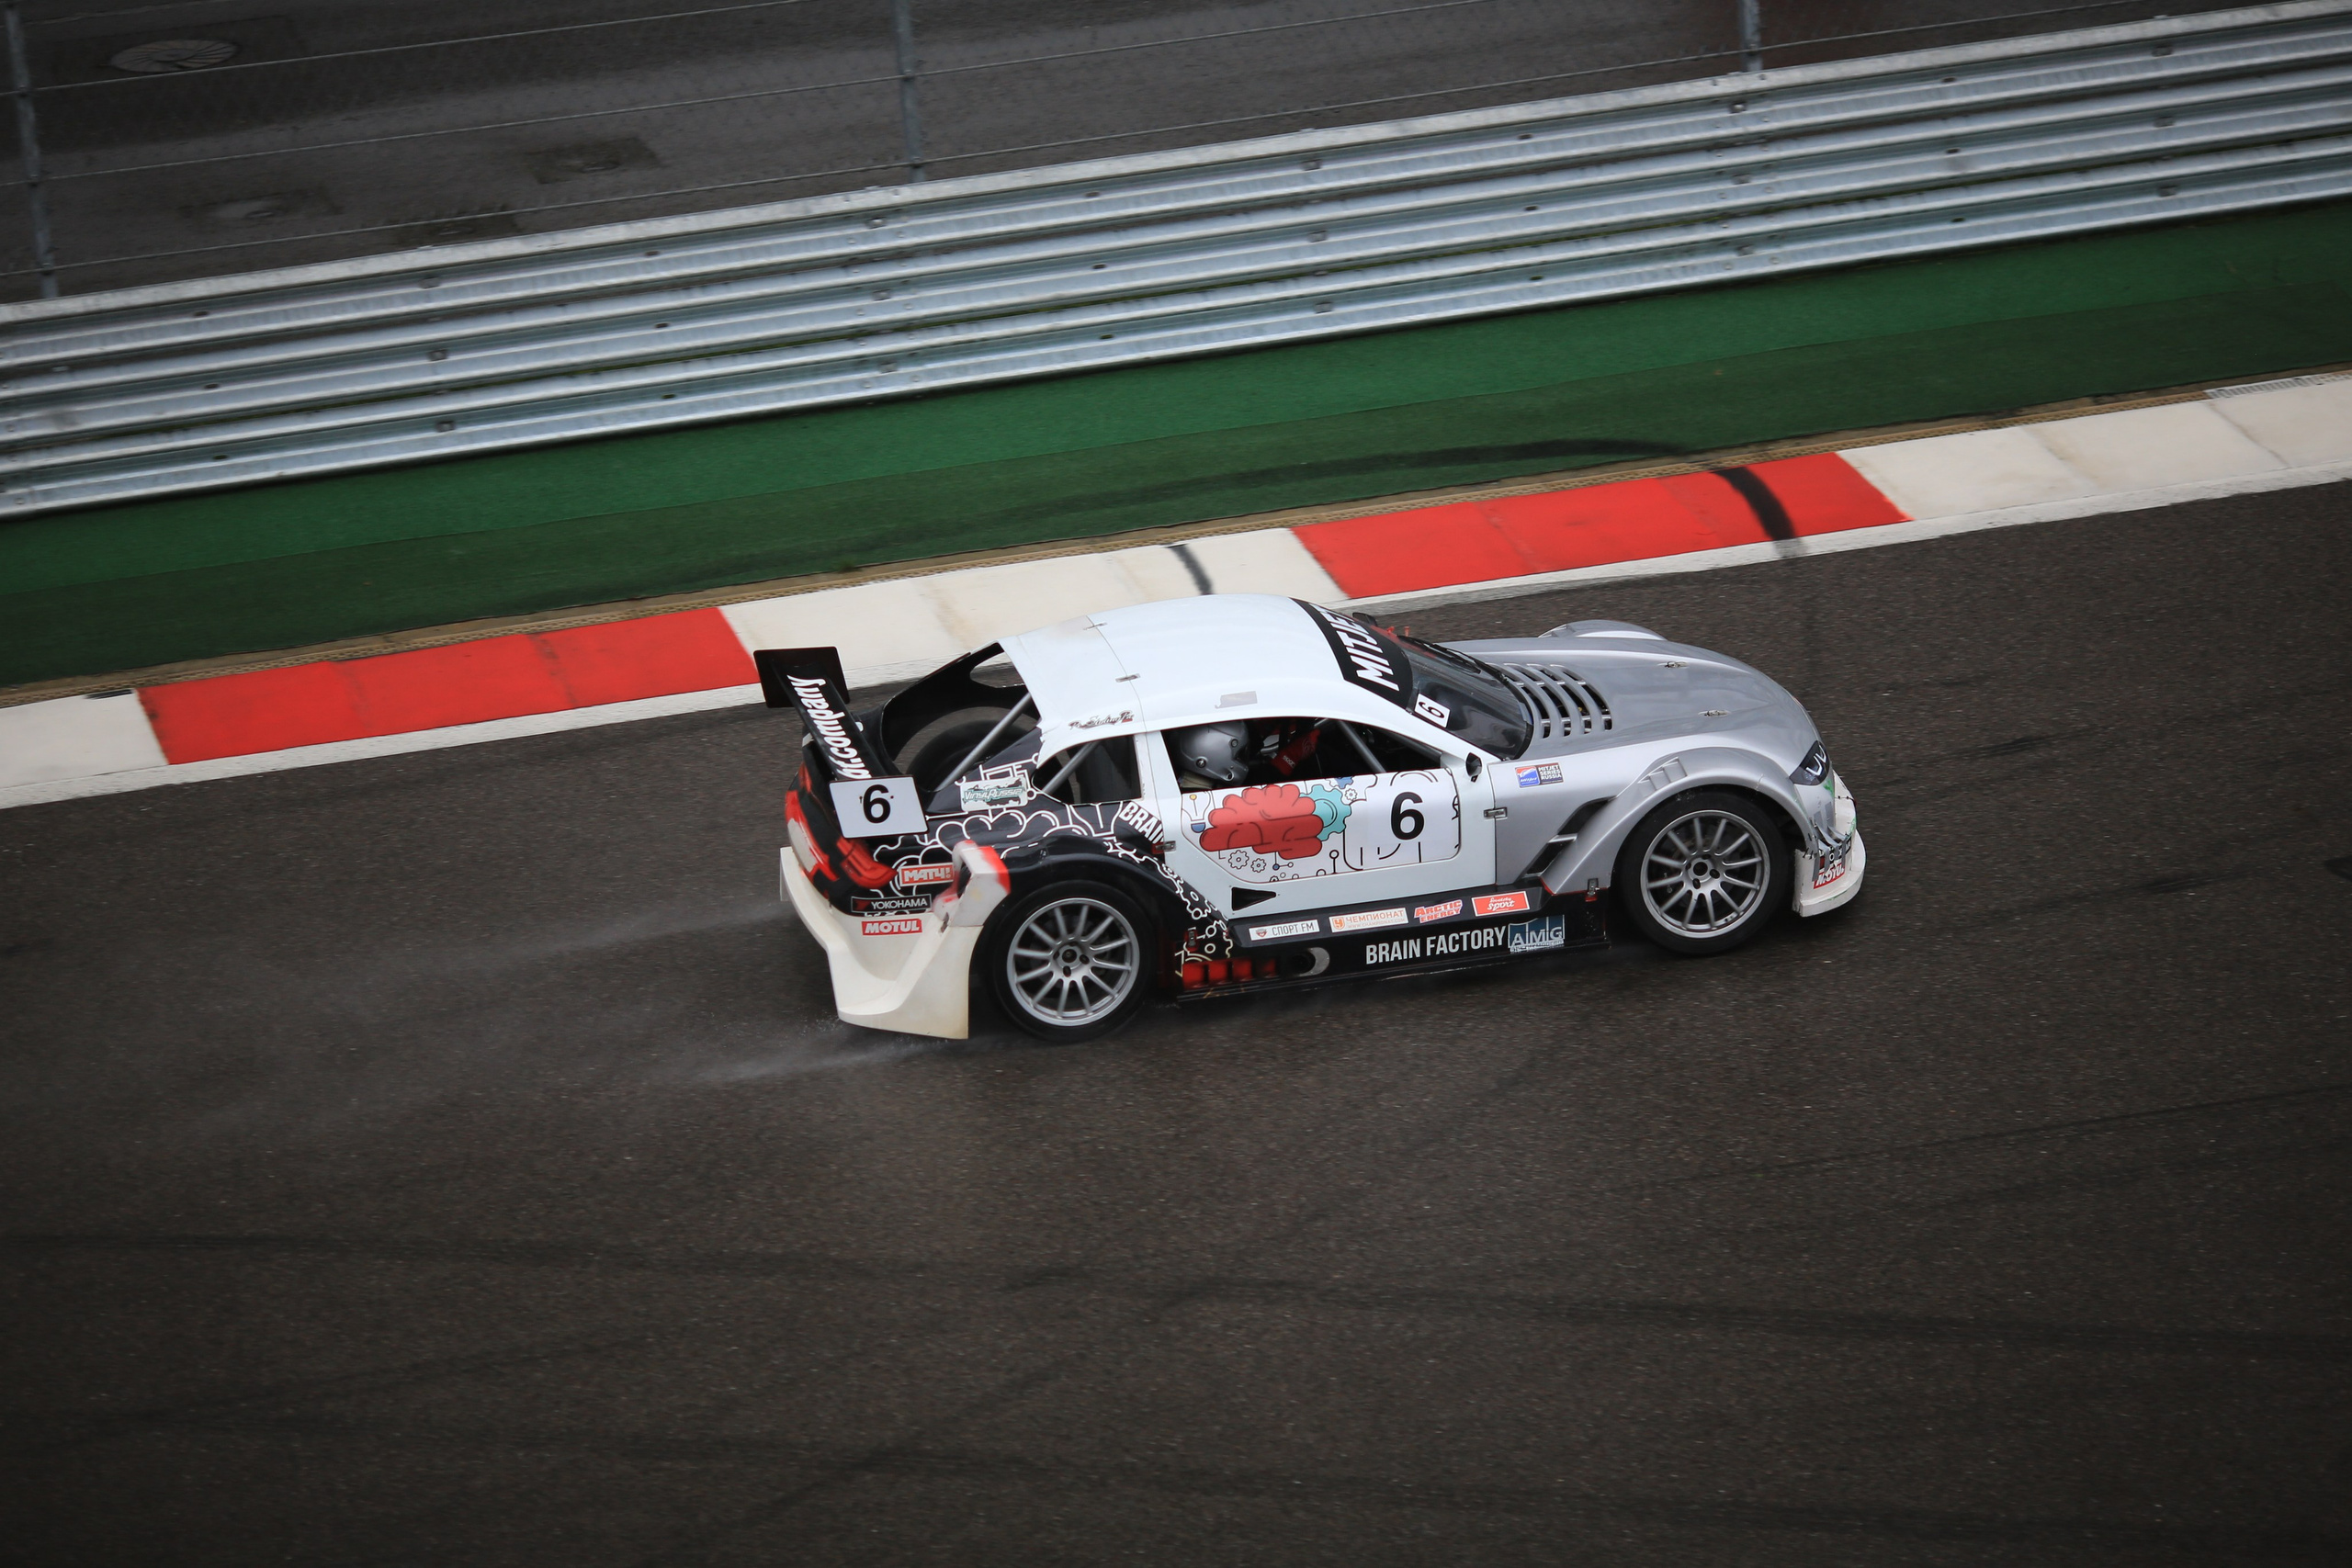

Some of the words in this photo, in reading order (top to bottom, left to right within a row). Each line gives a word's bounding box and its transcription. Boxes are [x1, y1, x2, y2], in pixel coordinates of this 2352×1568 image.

[1418, 701, 1445, 719] 6
[863, 784, 891, 824] 6
[1391, 791, 1424, 840] 6
[871, 898, 928, 910] YOKOHAMA
[1415, 900, 1462, 917] ARCTIC
[1345, 909, 1404, 923] ЧЕМПИОНАТ
[1420, 908, 1461, 922] ENERGY
[865, 920, 920, 933] MOTUL
[1272, 923, 1299, 936] СПОРТ
[1299, 921, 1315, 932] FM
[1365, 938, 1420, 964] BRAIN
[1426, 925, 1507, 956] FACTORY
[1511, 927, 1564, 947] AMG
